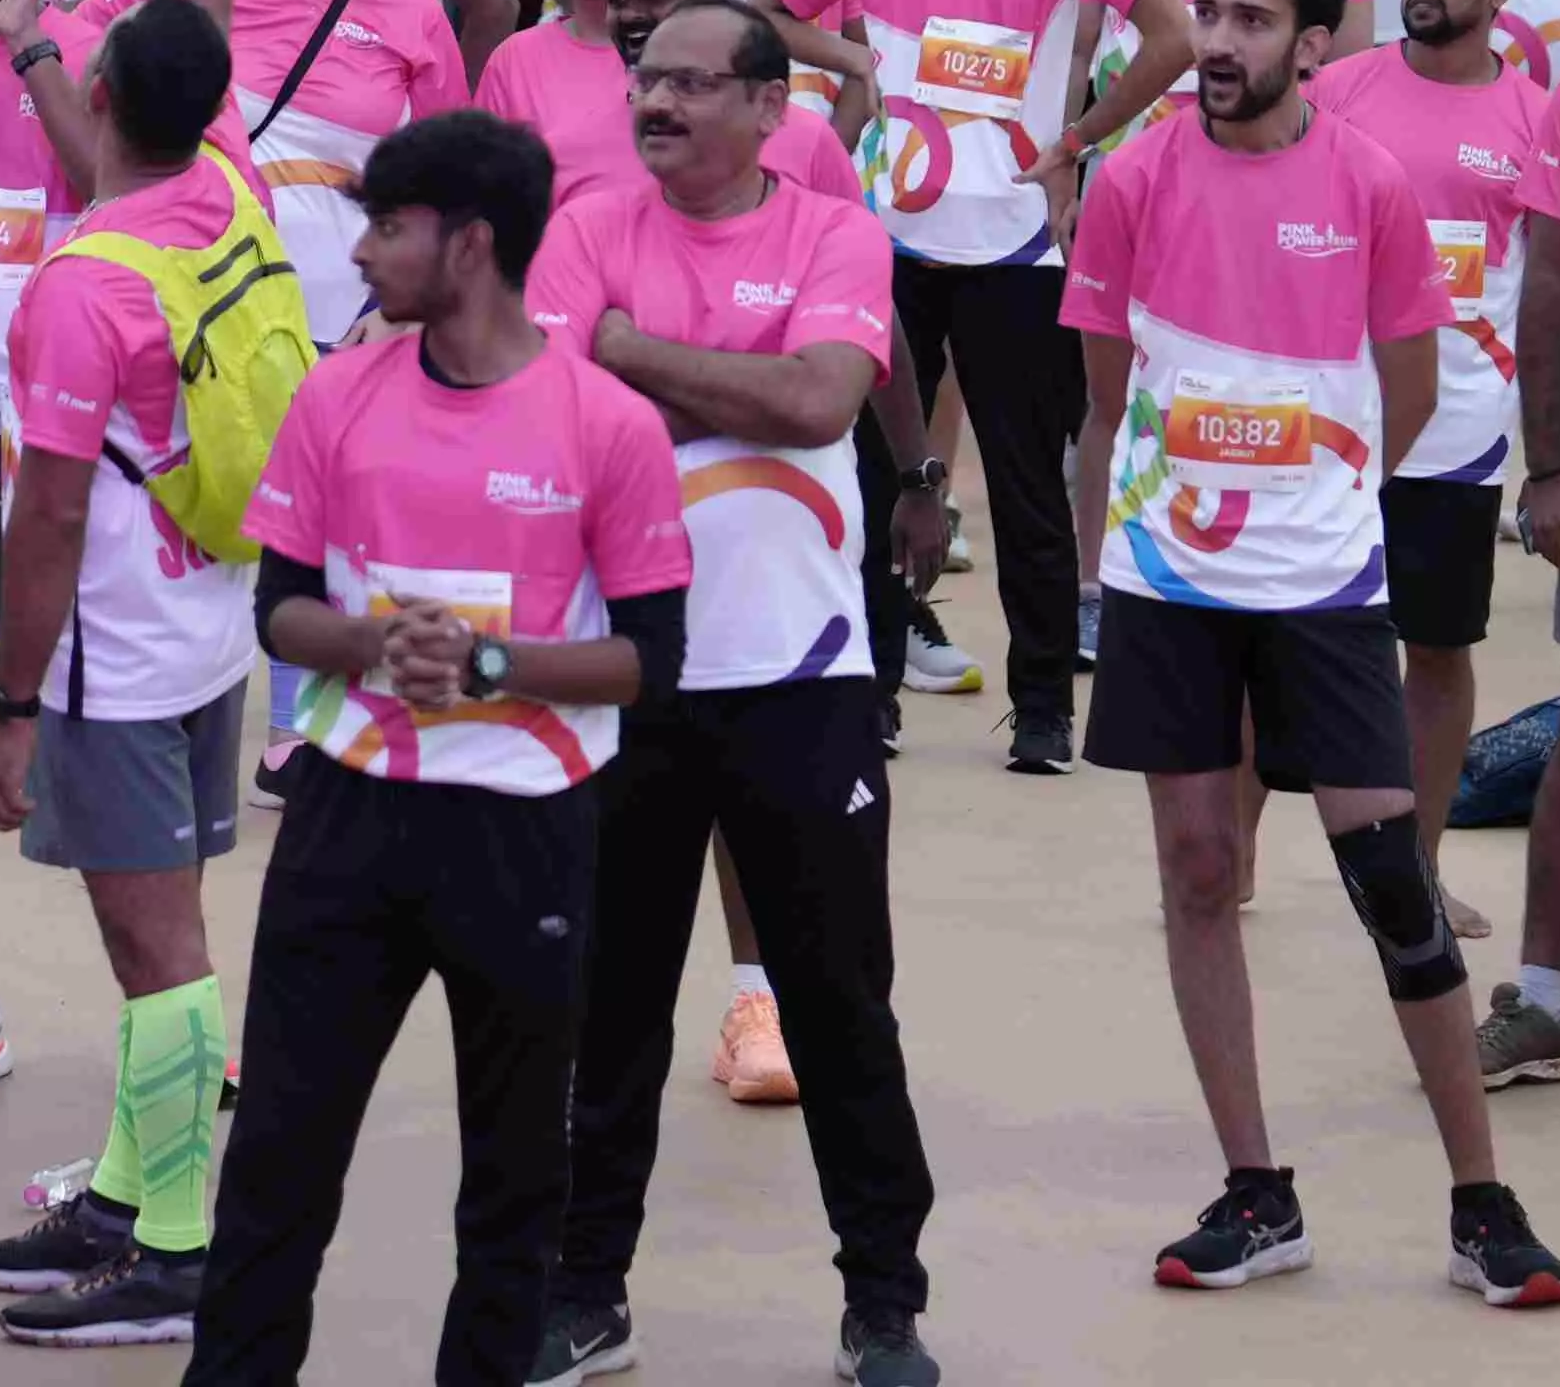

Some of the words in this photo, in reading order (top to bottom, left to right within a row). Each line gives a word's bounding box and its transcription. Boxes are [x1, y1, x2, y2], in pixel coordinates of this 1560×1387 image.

[943, 49, 1008, 82] 10275
[1278, 222, 1315, 238] PINK
[1278, 236, 1323, 248] POWER
[1333, 237, 1359, 248] RUN
[1196, 413, 1282, 447] 10382
